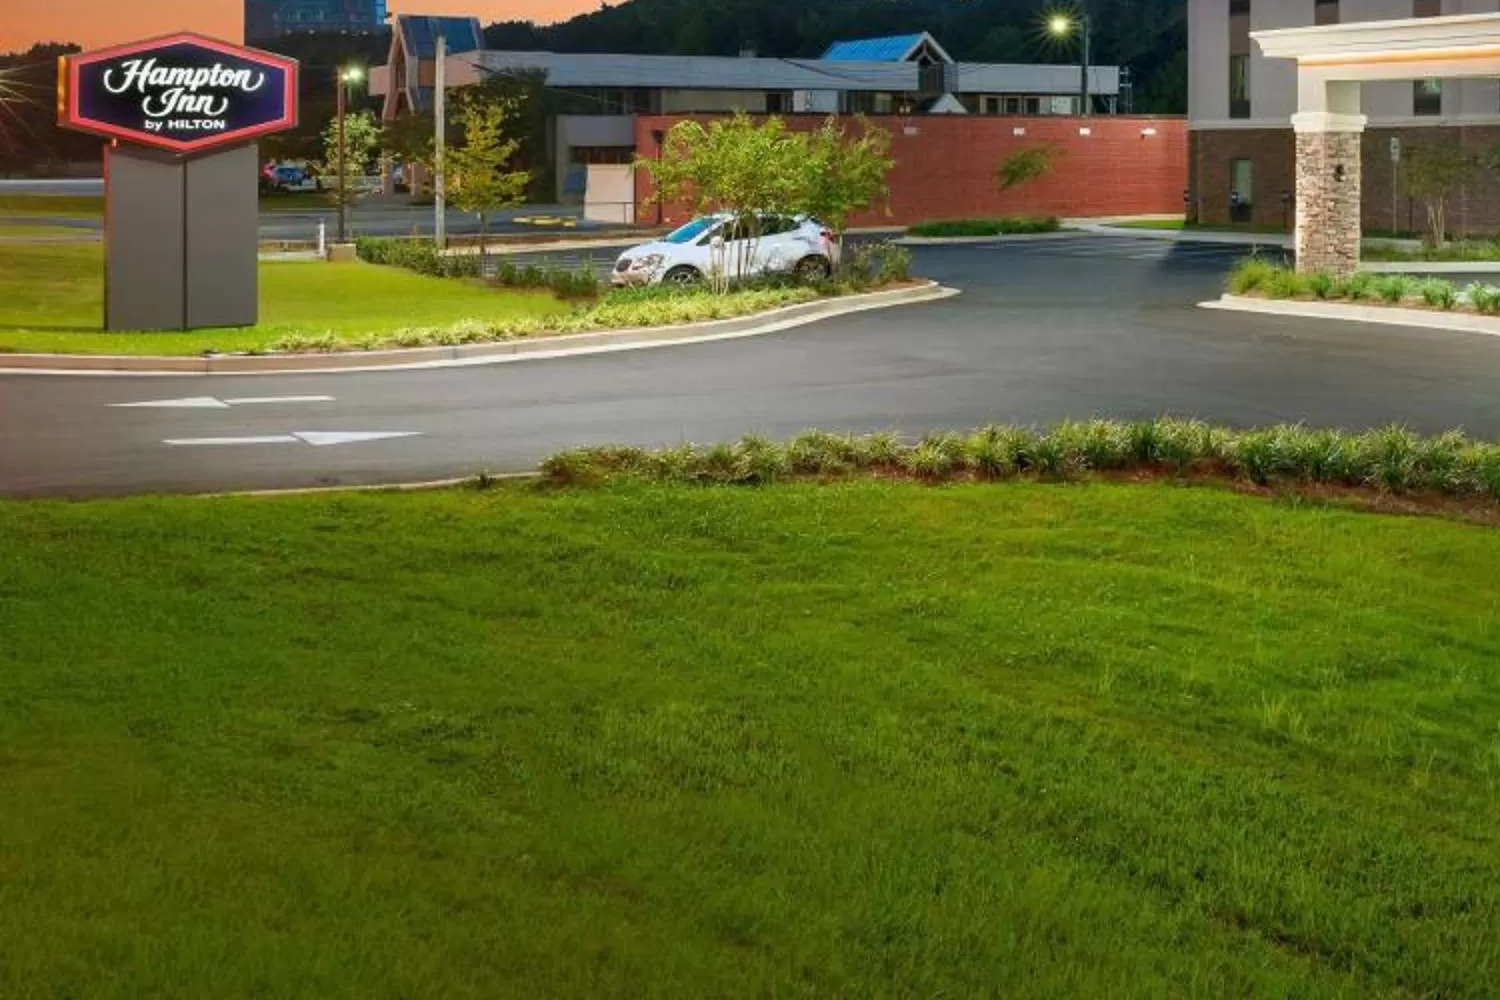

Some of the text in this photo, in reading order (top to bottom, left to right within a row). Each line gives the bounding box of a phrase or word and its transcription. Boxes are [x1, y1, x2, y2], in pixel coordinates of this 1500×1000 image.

[103, 57, 264, 93] Hampton
[142, 87, 228, 117] Inn
[144, 119, 225, 131] by HILTON
